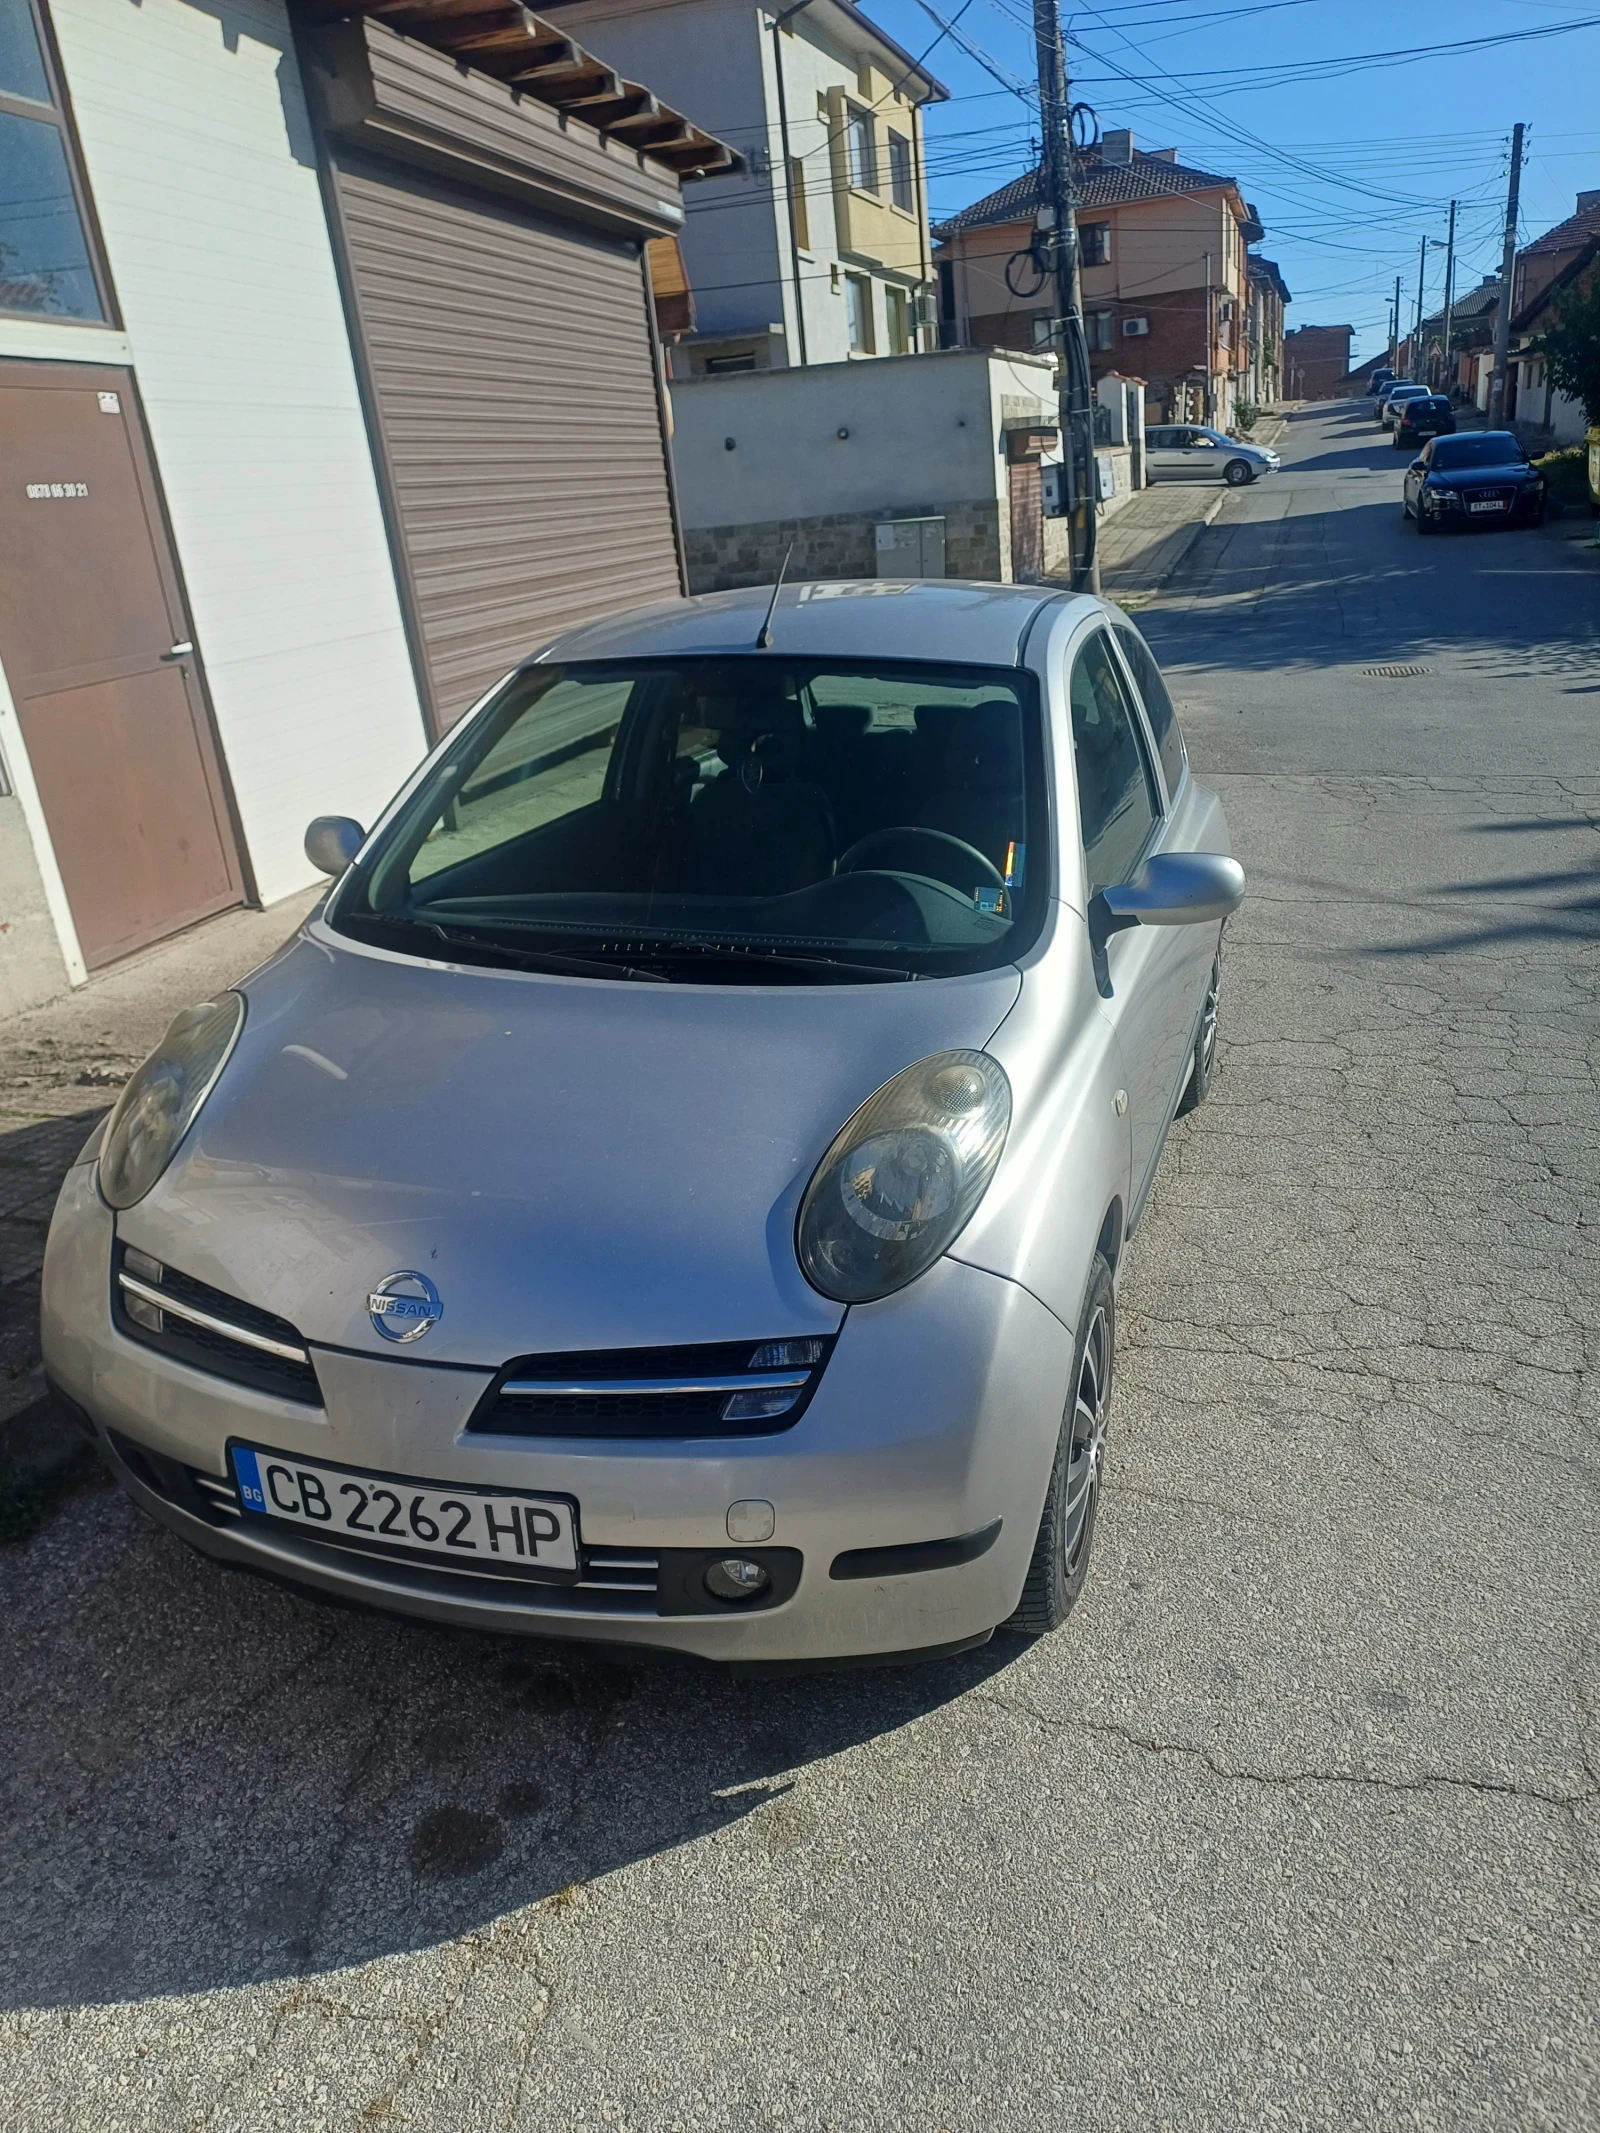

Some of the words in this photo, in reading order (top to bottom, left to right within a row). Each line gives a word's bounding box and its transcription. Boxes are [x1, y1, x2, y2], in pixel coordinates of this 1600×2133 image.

[371, 1298, 431, 1316] NISSAN
[242, 1485, 262, 1502] BG
[266, 1464, 332, 1522] CB
[339, 1483, 477, 1549] 2262
[484, 1504, 561, 1557] HP
